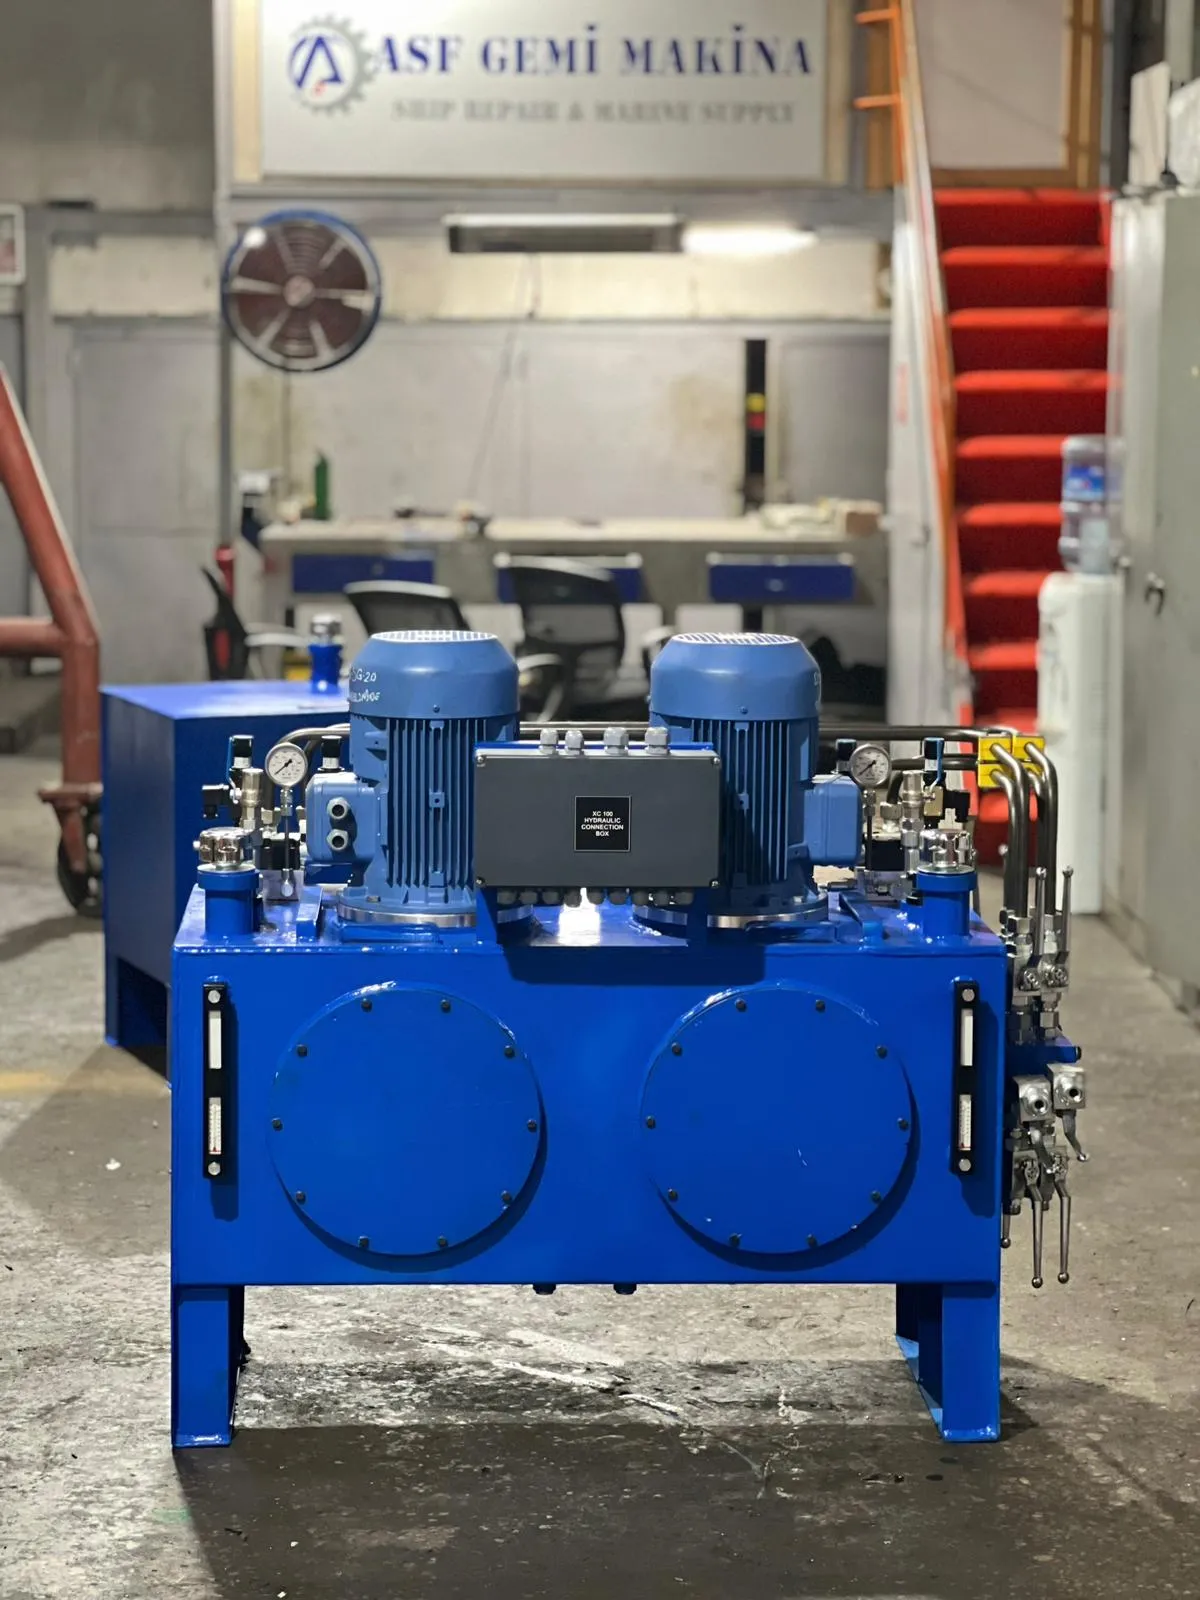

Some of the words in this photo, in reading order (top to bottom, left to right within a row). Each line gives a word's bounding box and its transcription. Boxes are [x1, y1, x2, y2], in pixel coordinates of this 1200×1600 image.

[373, 36, 461, 75] ASF
[481, 23, 600, 76] GEMİ
[621, 23, 814, 76] MAKİNA
